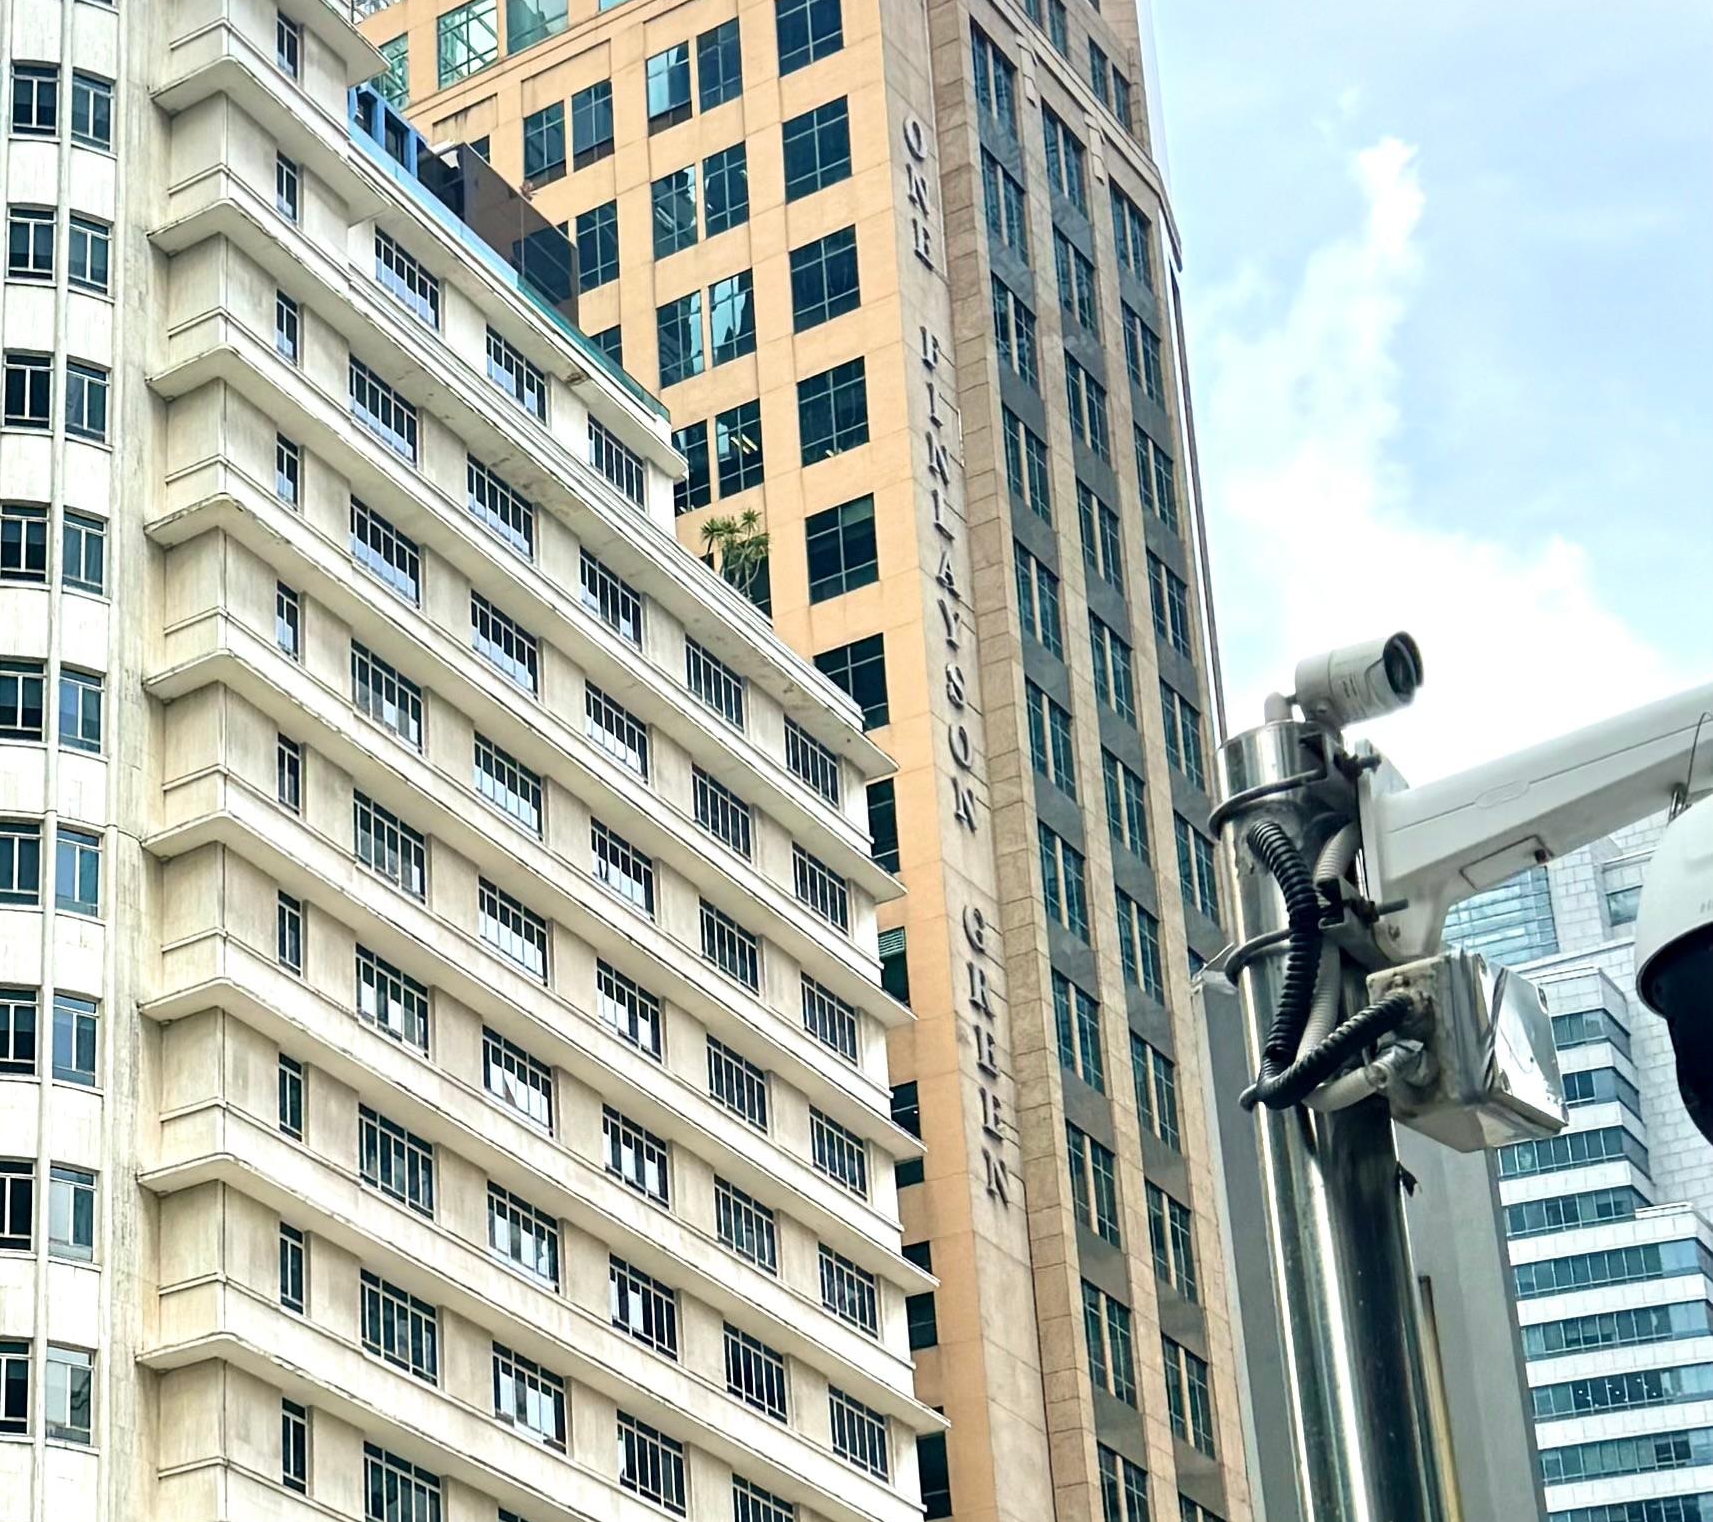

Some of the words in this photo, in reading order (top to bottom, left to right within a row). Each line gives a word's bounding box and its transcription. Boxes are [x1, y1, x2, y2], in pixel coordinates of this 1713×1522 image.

[903, 116, 935, 271] ONE
[920, 326, 977, 835] FINLAYSON
[963, 904, 1009, 1210] GREEN
